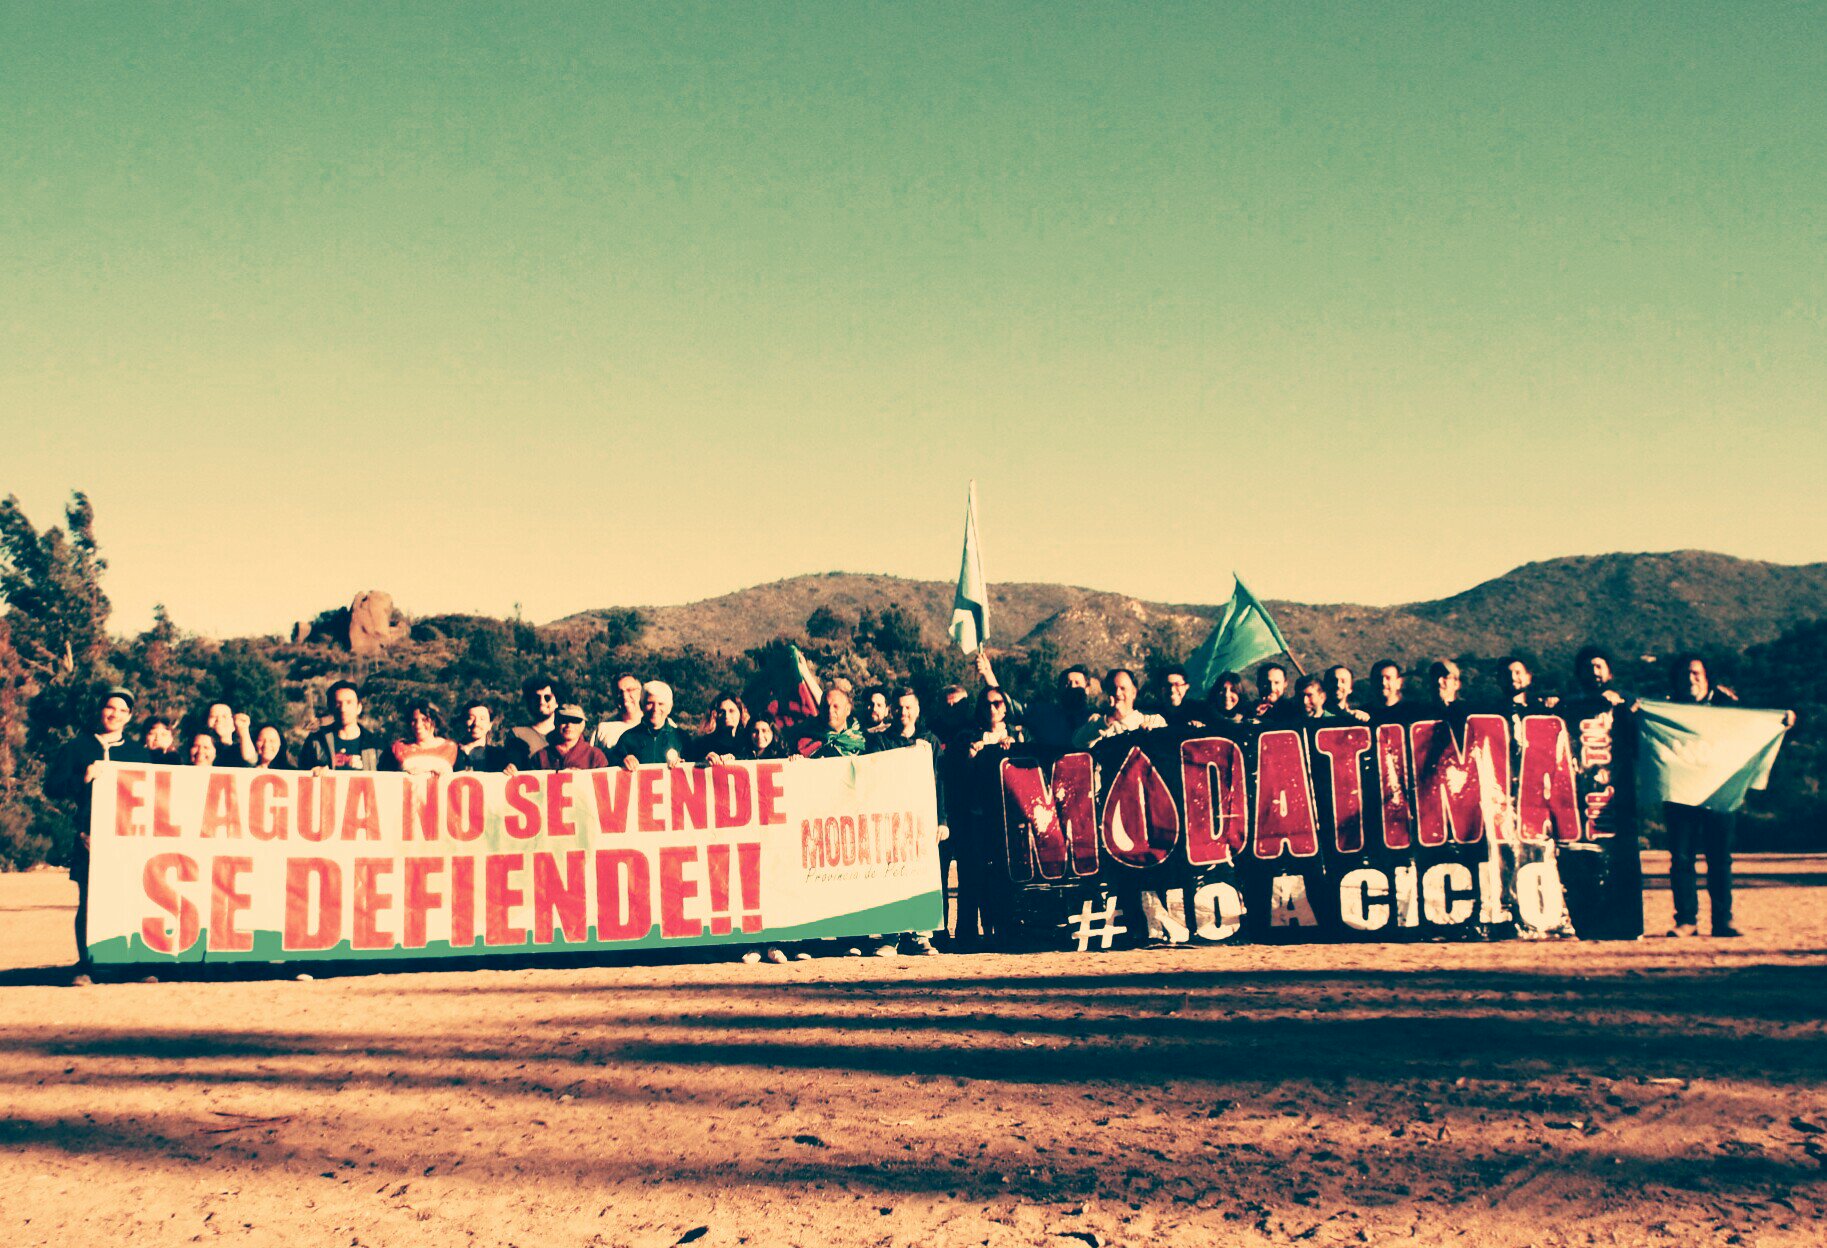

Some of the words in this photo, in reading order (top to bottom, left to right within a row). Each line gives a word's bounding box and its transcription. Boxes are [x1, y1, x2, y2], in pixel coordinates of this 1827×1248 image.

[115, 769, 181, 837] EL
[200, 773, 382, 842] AGUA
[402, 775, 485, 842] NO
[504, 772, 576, 840] SE
[592, 763, 787, 834] VENDE
[142, 852, 254, 953] SE
[283, 842, 763, 950] DEFIENDE!!
[1270, 875, 1318, 927] A
